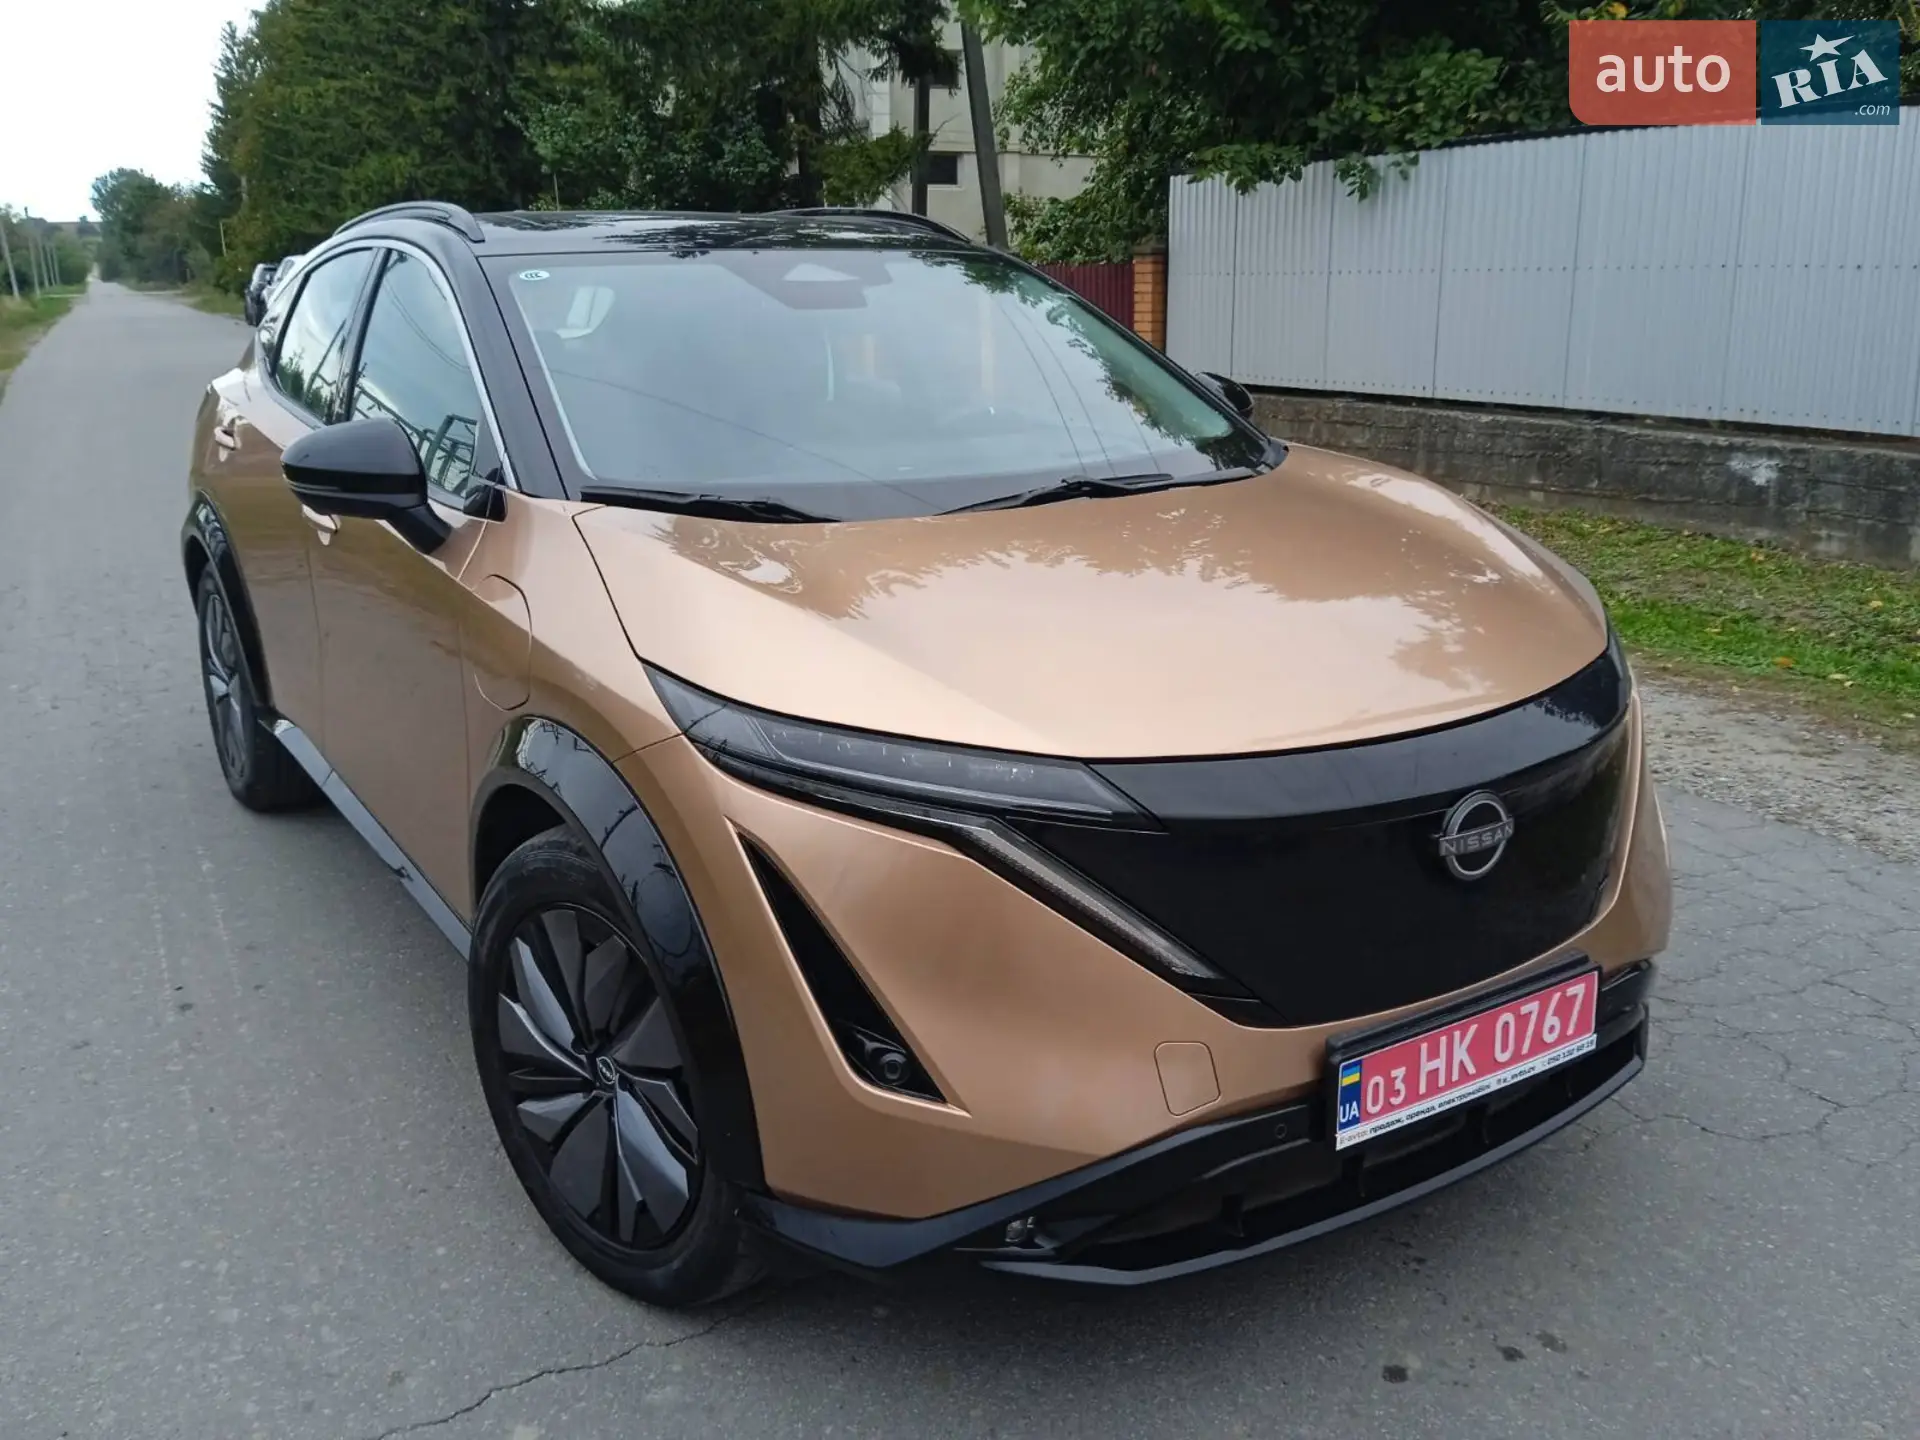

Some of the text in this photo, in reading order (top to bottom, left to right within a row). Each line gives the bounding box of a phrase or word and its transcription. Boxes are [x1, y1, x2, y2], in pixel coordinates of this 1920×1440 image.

[1442, 824, 1513, 856] NISSAN
[1366, 1066, 1406, 1115] 03
[1419, 1023, 1479, 1095] HK
[1494, 983, 1586, 1063] 0767
[1339, 1100, 1360, 1123] UA
